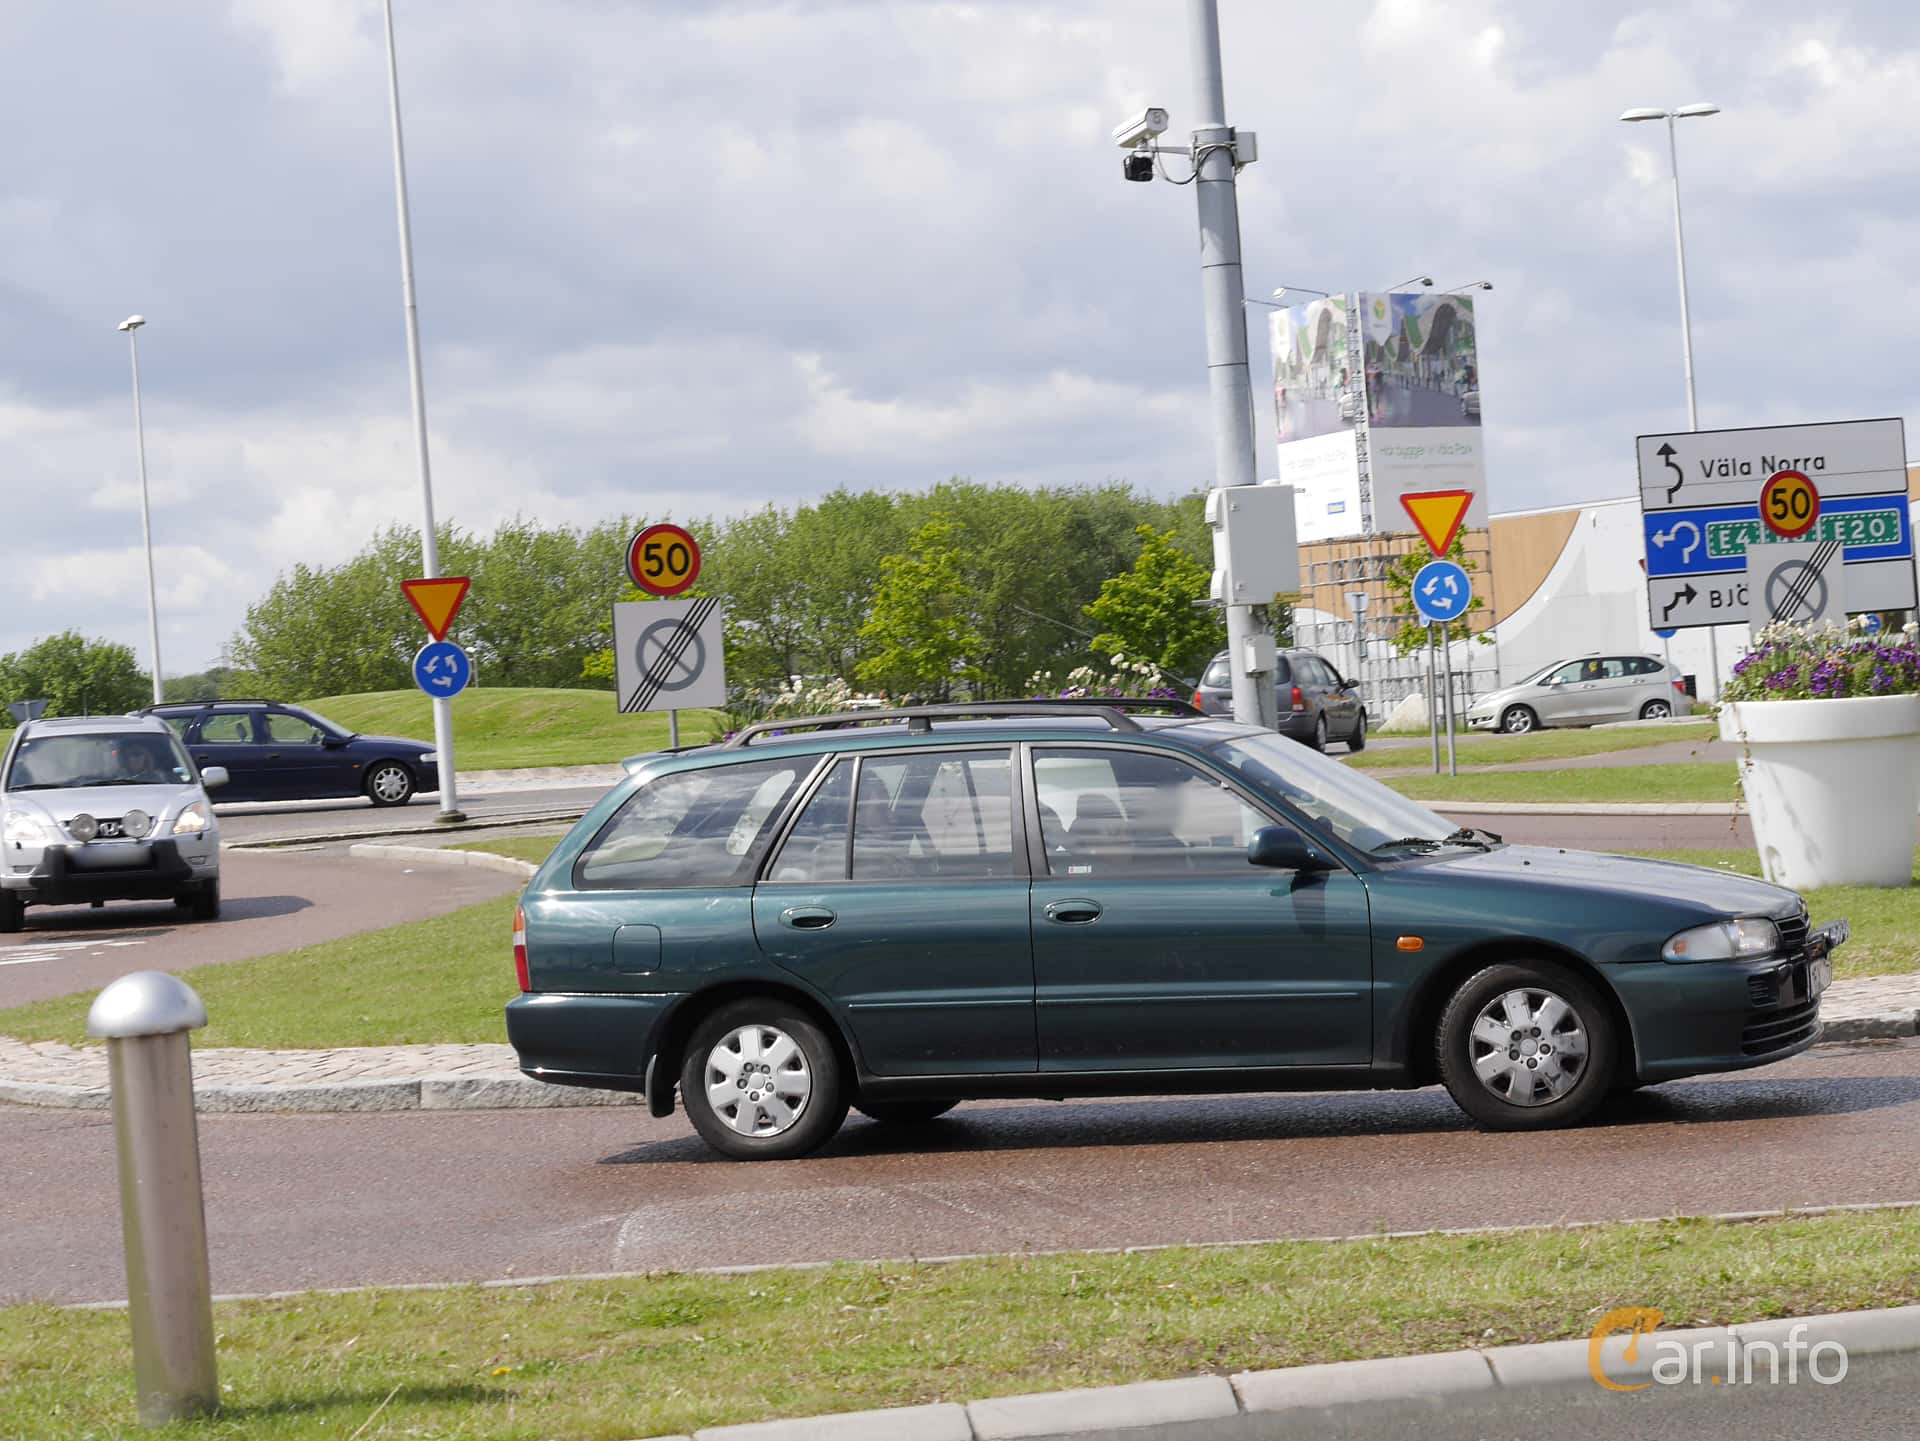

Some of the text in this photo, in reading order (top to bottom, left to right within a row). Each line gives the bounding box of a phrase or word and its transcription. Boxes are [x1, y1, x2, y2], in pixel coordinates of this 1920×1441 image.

[1700, 456, 1825, 478] Väla Norra
[1771, 488, 1811, 520] 50
[1719, 528, 1751, 549] E4
[1834, 519, 1885, 540] E20
[644, 543, 690, 577] 50
[1710, 583, 1749, 608] BJÖ
